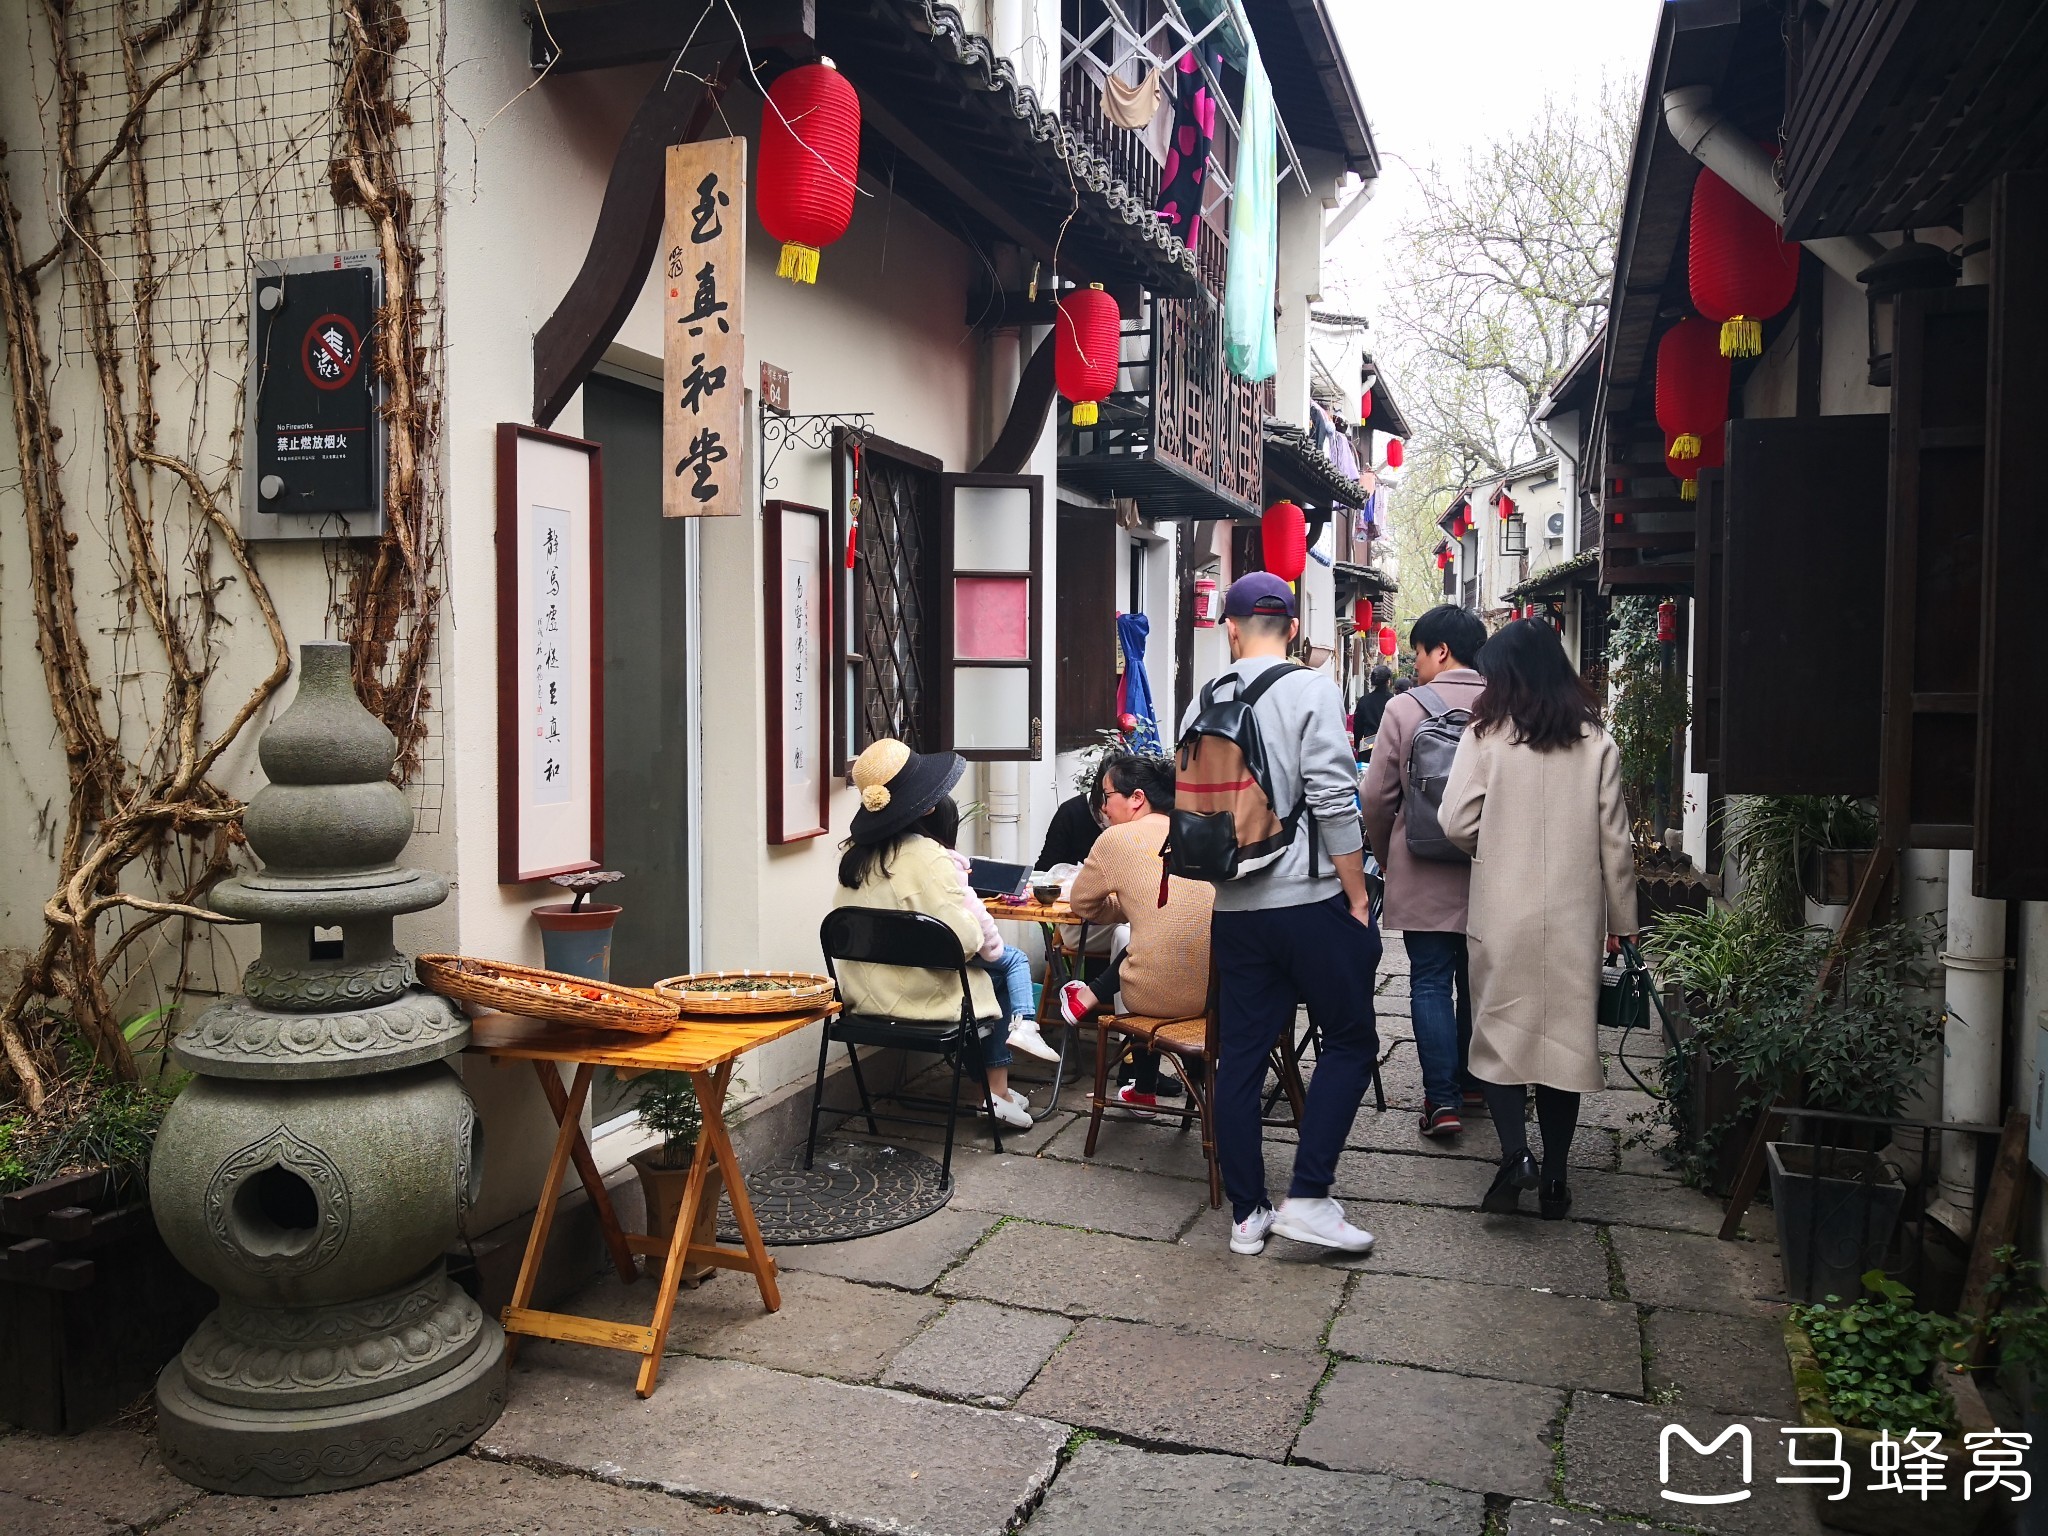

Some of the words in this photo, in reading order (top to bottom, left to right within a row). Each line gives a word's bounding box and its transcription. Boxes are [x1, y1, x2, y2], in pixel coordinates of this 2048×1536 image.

[770, 383, 781, 405] 64
[286, 422, 314, 430] Fireworks
[277, 433, 348, 452] 禁止燃放烟火
